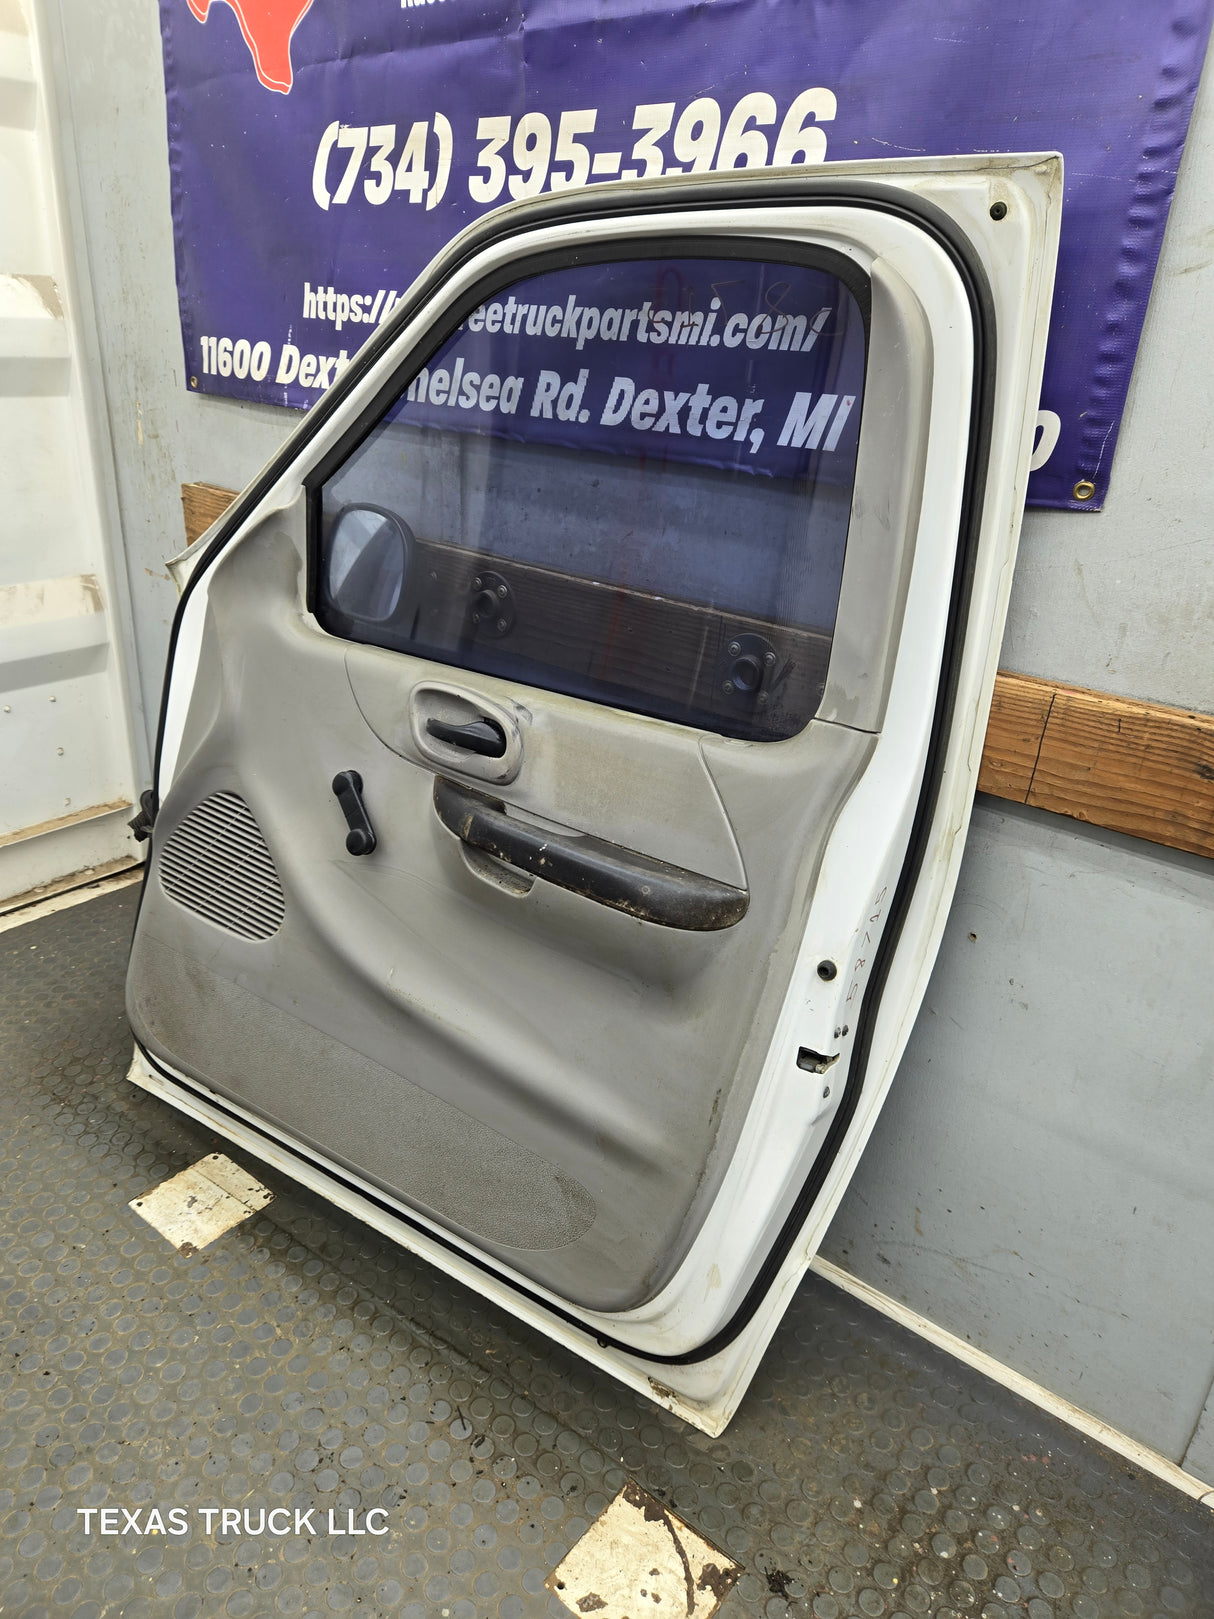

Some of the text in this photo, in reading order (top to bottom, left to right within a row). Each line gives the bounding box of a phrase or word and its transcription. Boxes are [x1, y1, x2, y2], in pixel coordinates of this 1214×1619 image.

[312, 87, 838, 211] (734) 395-3966
[200, 336, 270, 382] 11600
[276, 344, 352, 389] Dext
[530, 368, 591, 423] Rd.
[600, 376, 765, 454] Dexter,
[776, 391, 857, 452] MI
